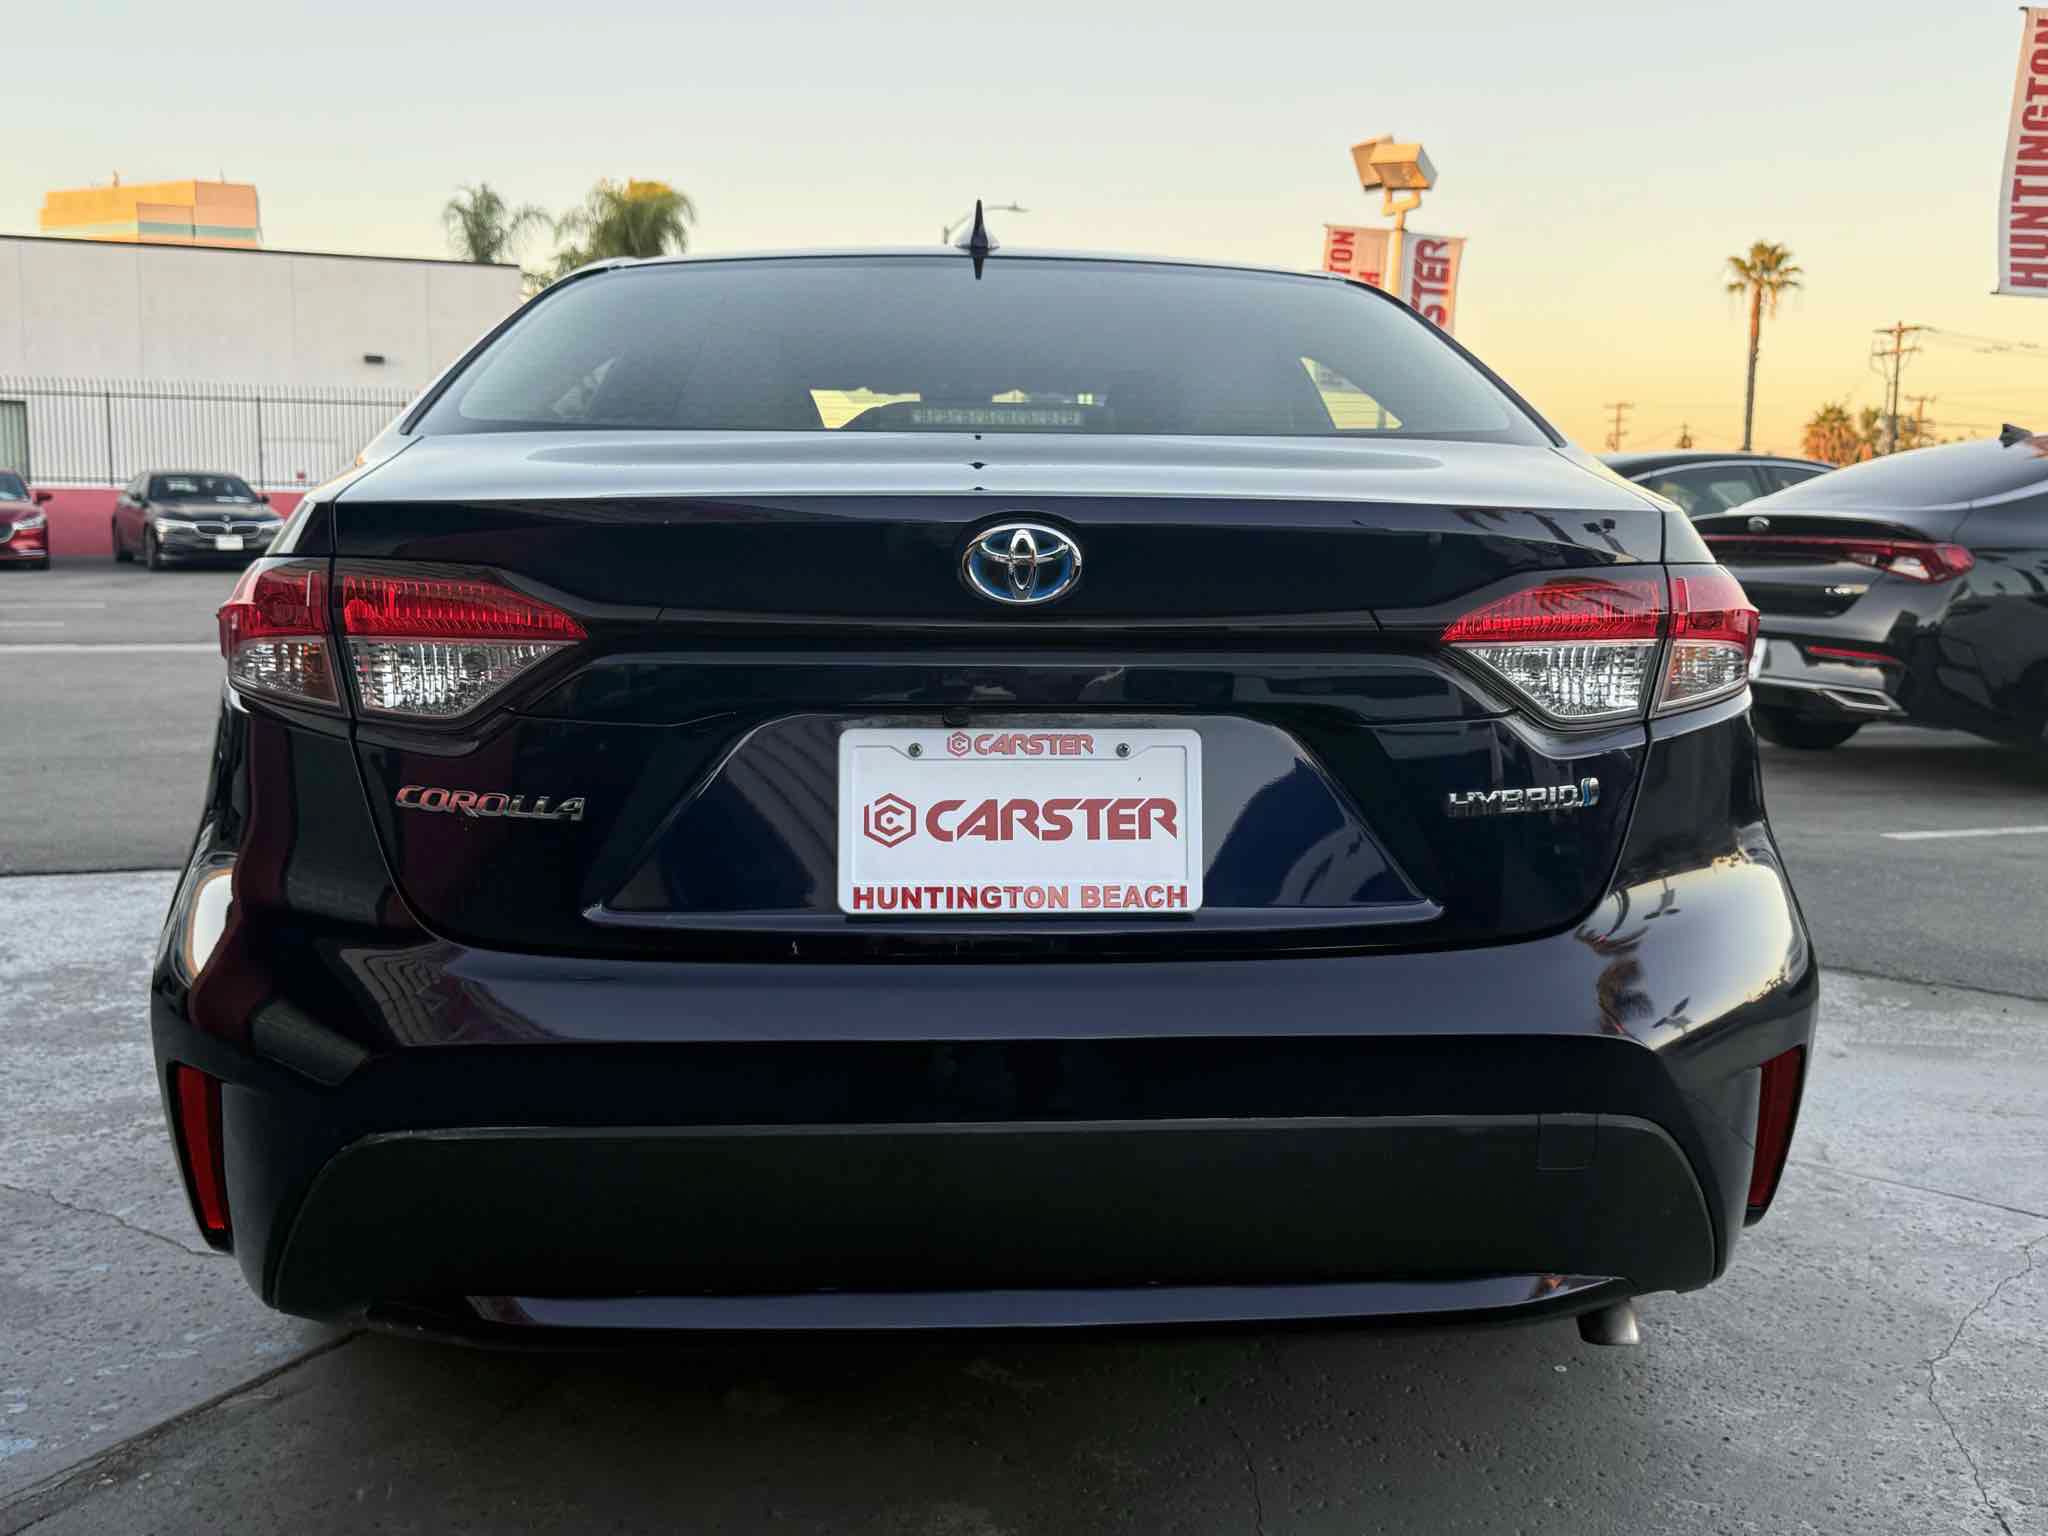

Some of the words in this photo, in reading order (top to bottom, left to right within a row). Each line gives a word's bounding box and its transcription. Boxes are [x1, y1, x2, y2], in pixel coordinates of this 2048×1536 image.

[974, 734, 1095, 755] CARSTER
[395, 785, 585, 821] COROLLA
[1448, 785, 1579, 817] HYBRID
[925, 798, 1178, 842] CARSTER
[852, 886, 1070, 910] HUNTINGTON
[1080, 885, 1188, 909] BEACH
